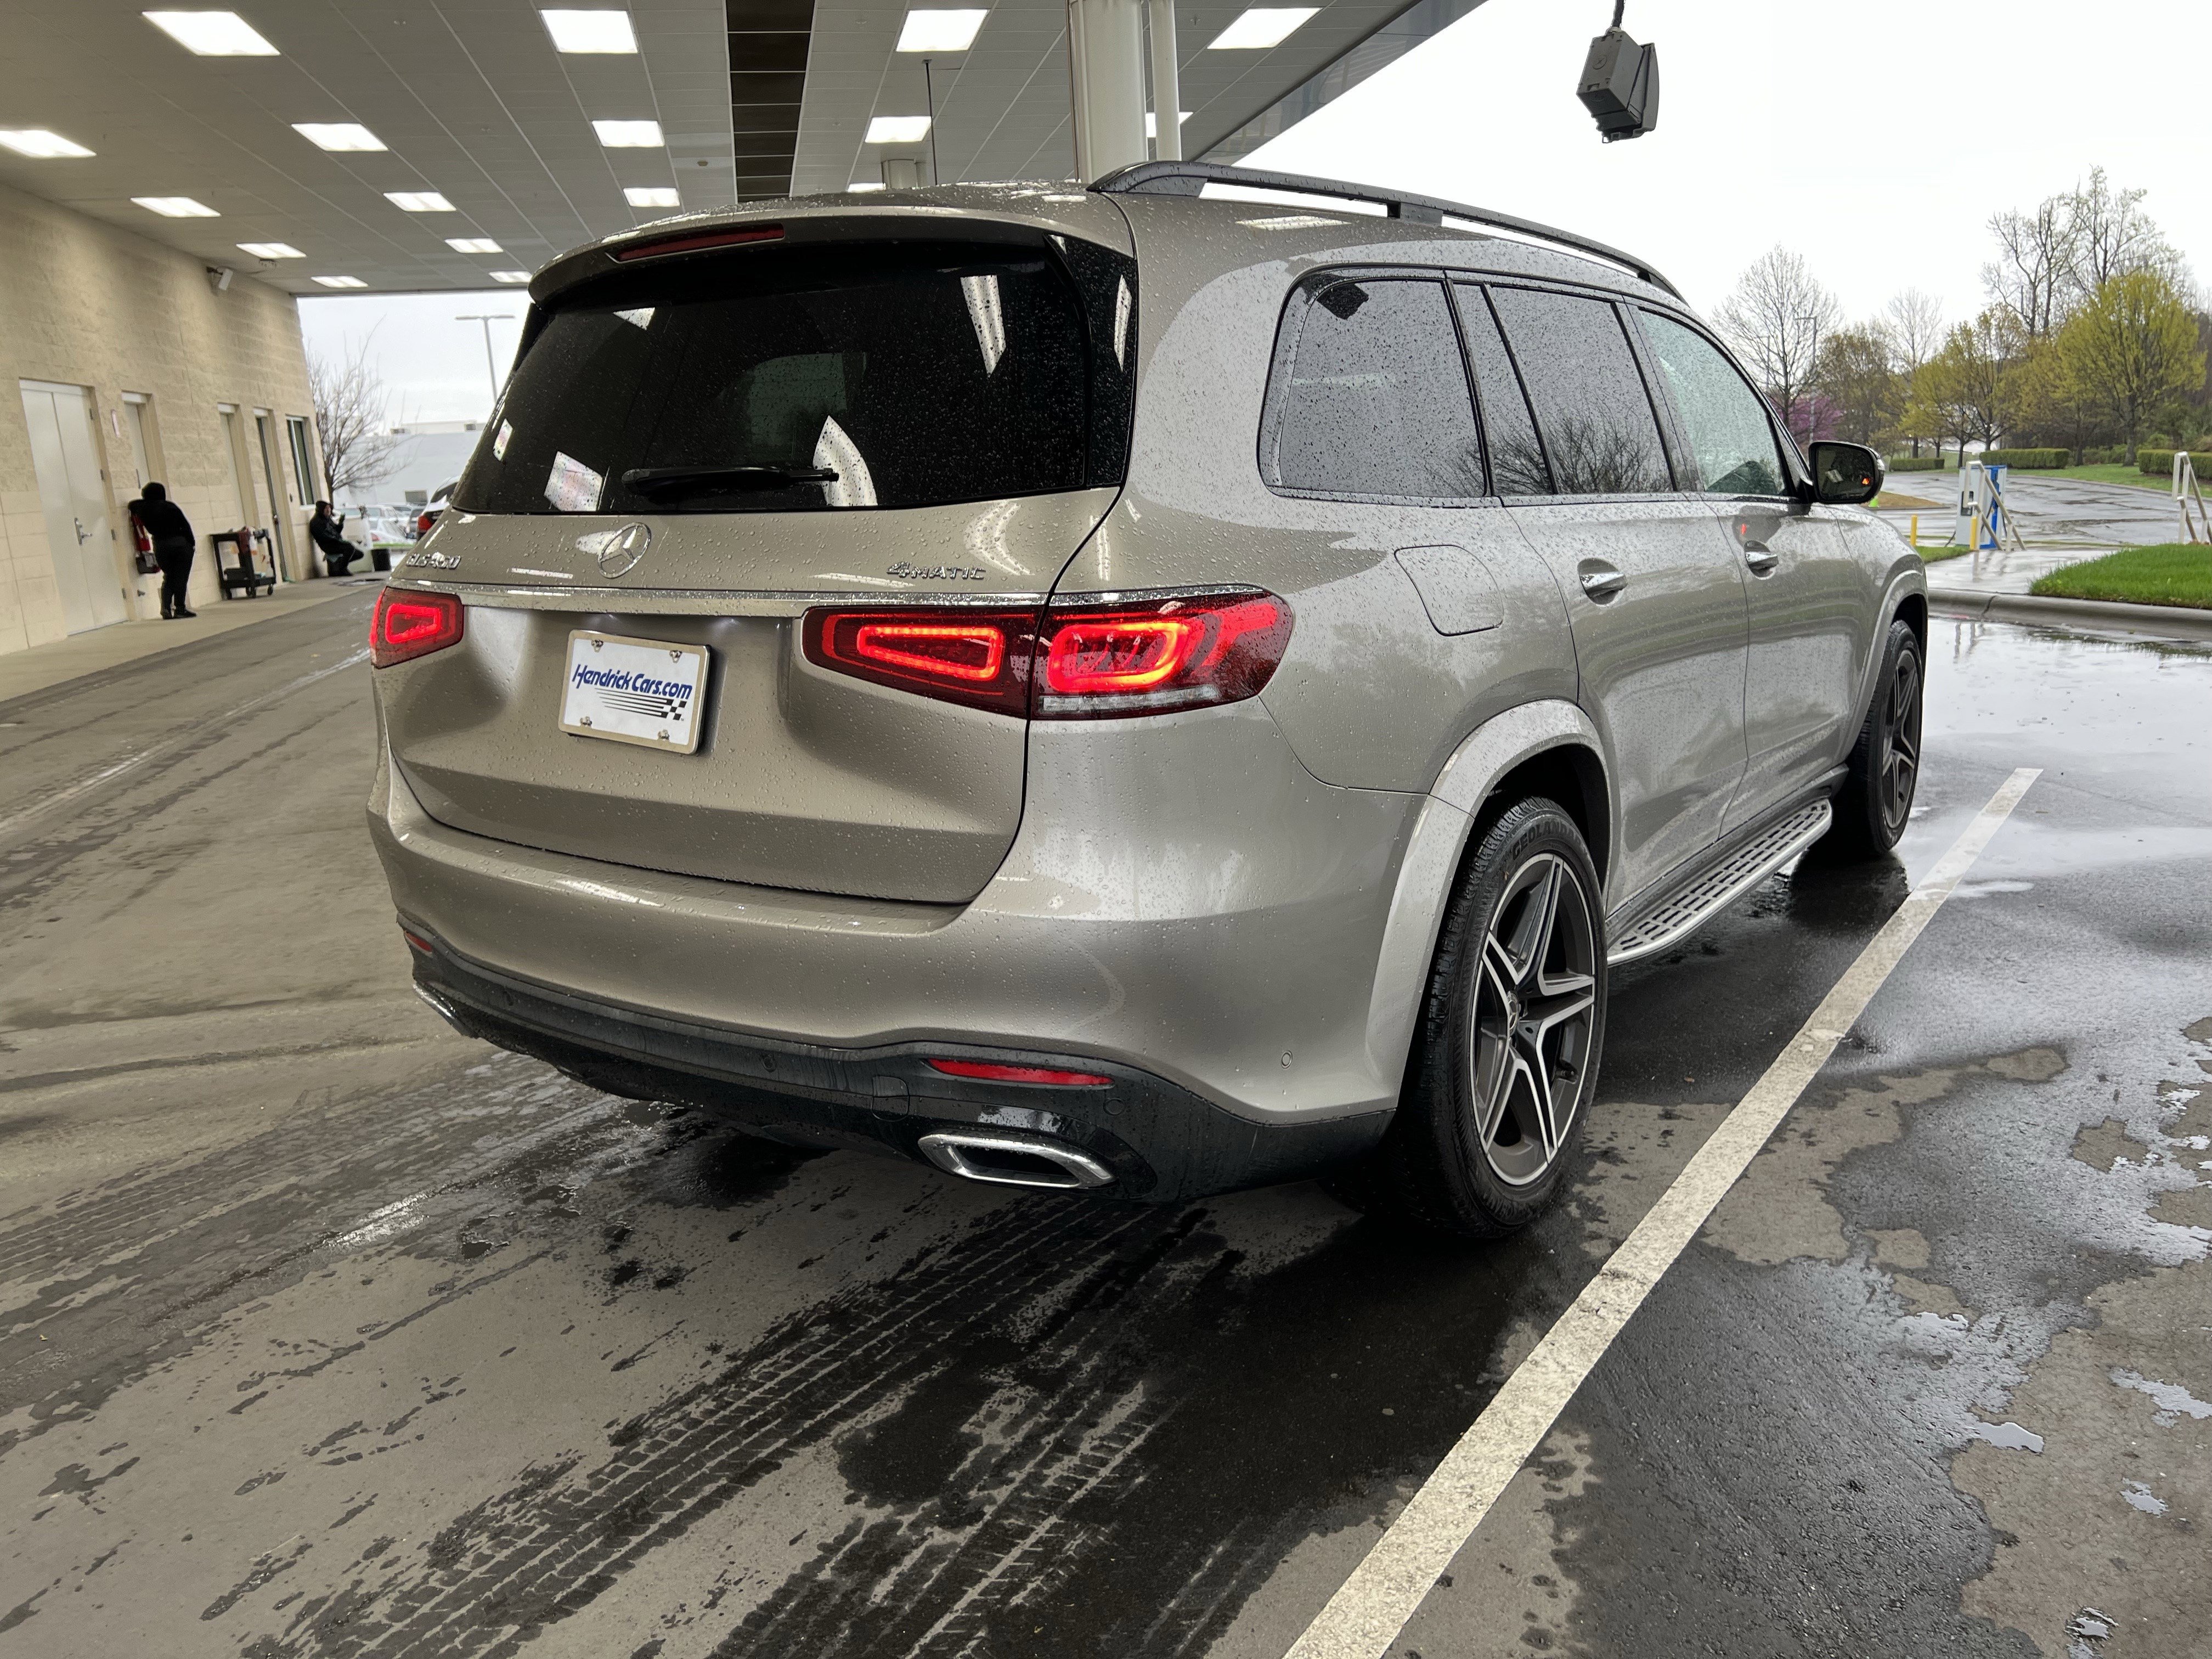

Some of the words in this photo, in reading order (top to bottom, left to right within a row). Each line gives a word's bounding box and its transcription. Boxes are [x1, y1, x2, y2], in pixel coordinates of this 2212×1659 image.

[886, 561, 986, 580] 4MATIC
[572, 664, 633, 689] Hendrick
[631, 673, 693, 699] Cars.com
